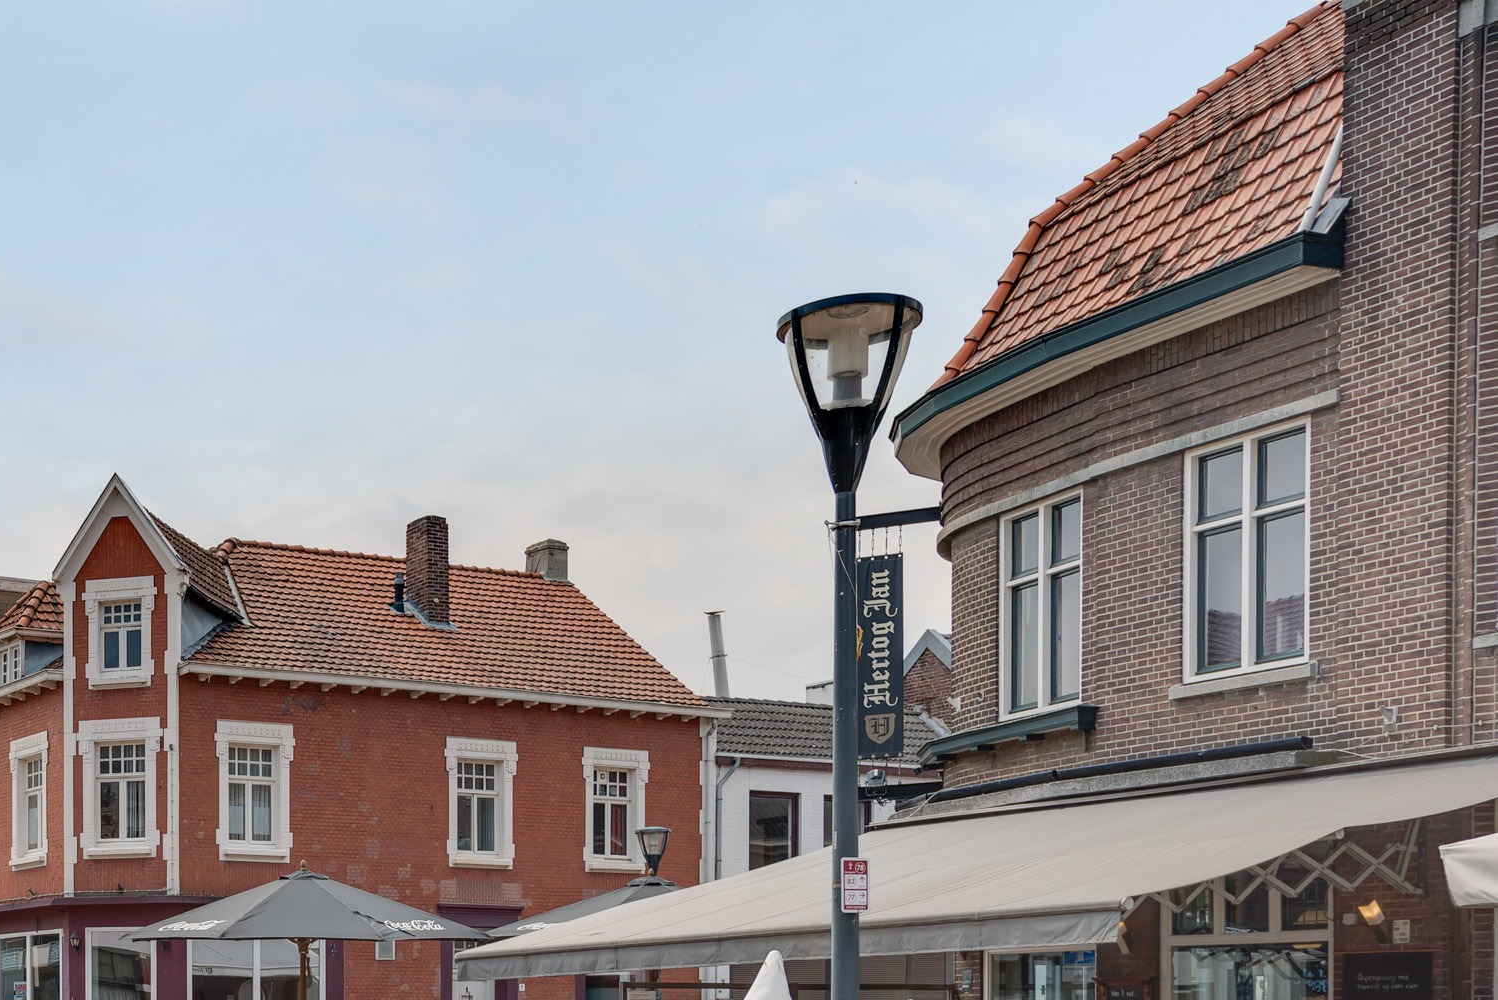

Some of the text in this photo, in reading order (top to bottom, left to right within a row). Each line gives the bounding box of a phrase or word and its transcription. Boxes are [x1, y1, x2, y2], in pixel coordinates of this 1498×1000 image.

[863, 569, 898, 709] Hertog Jan
[383, 919, 446, 932] Coca-Cola
